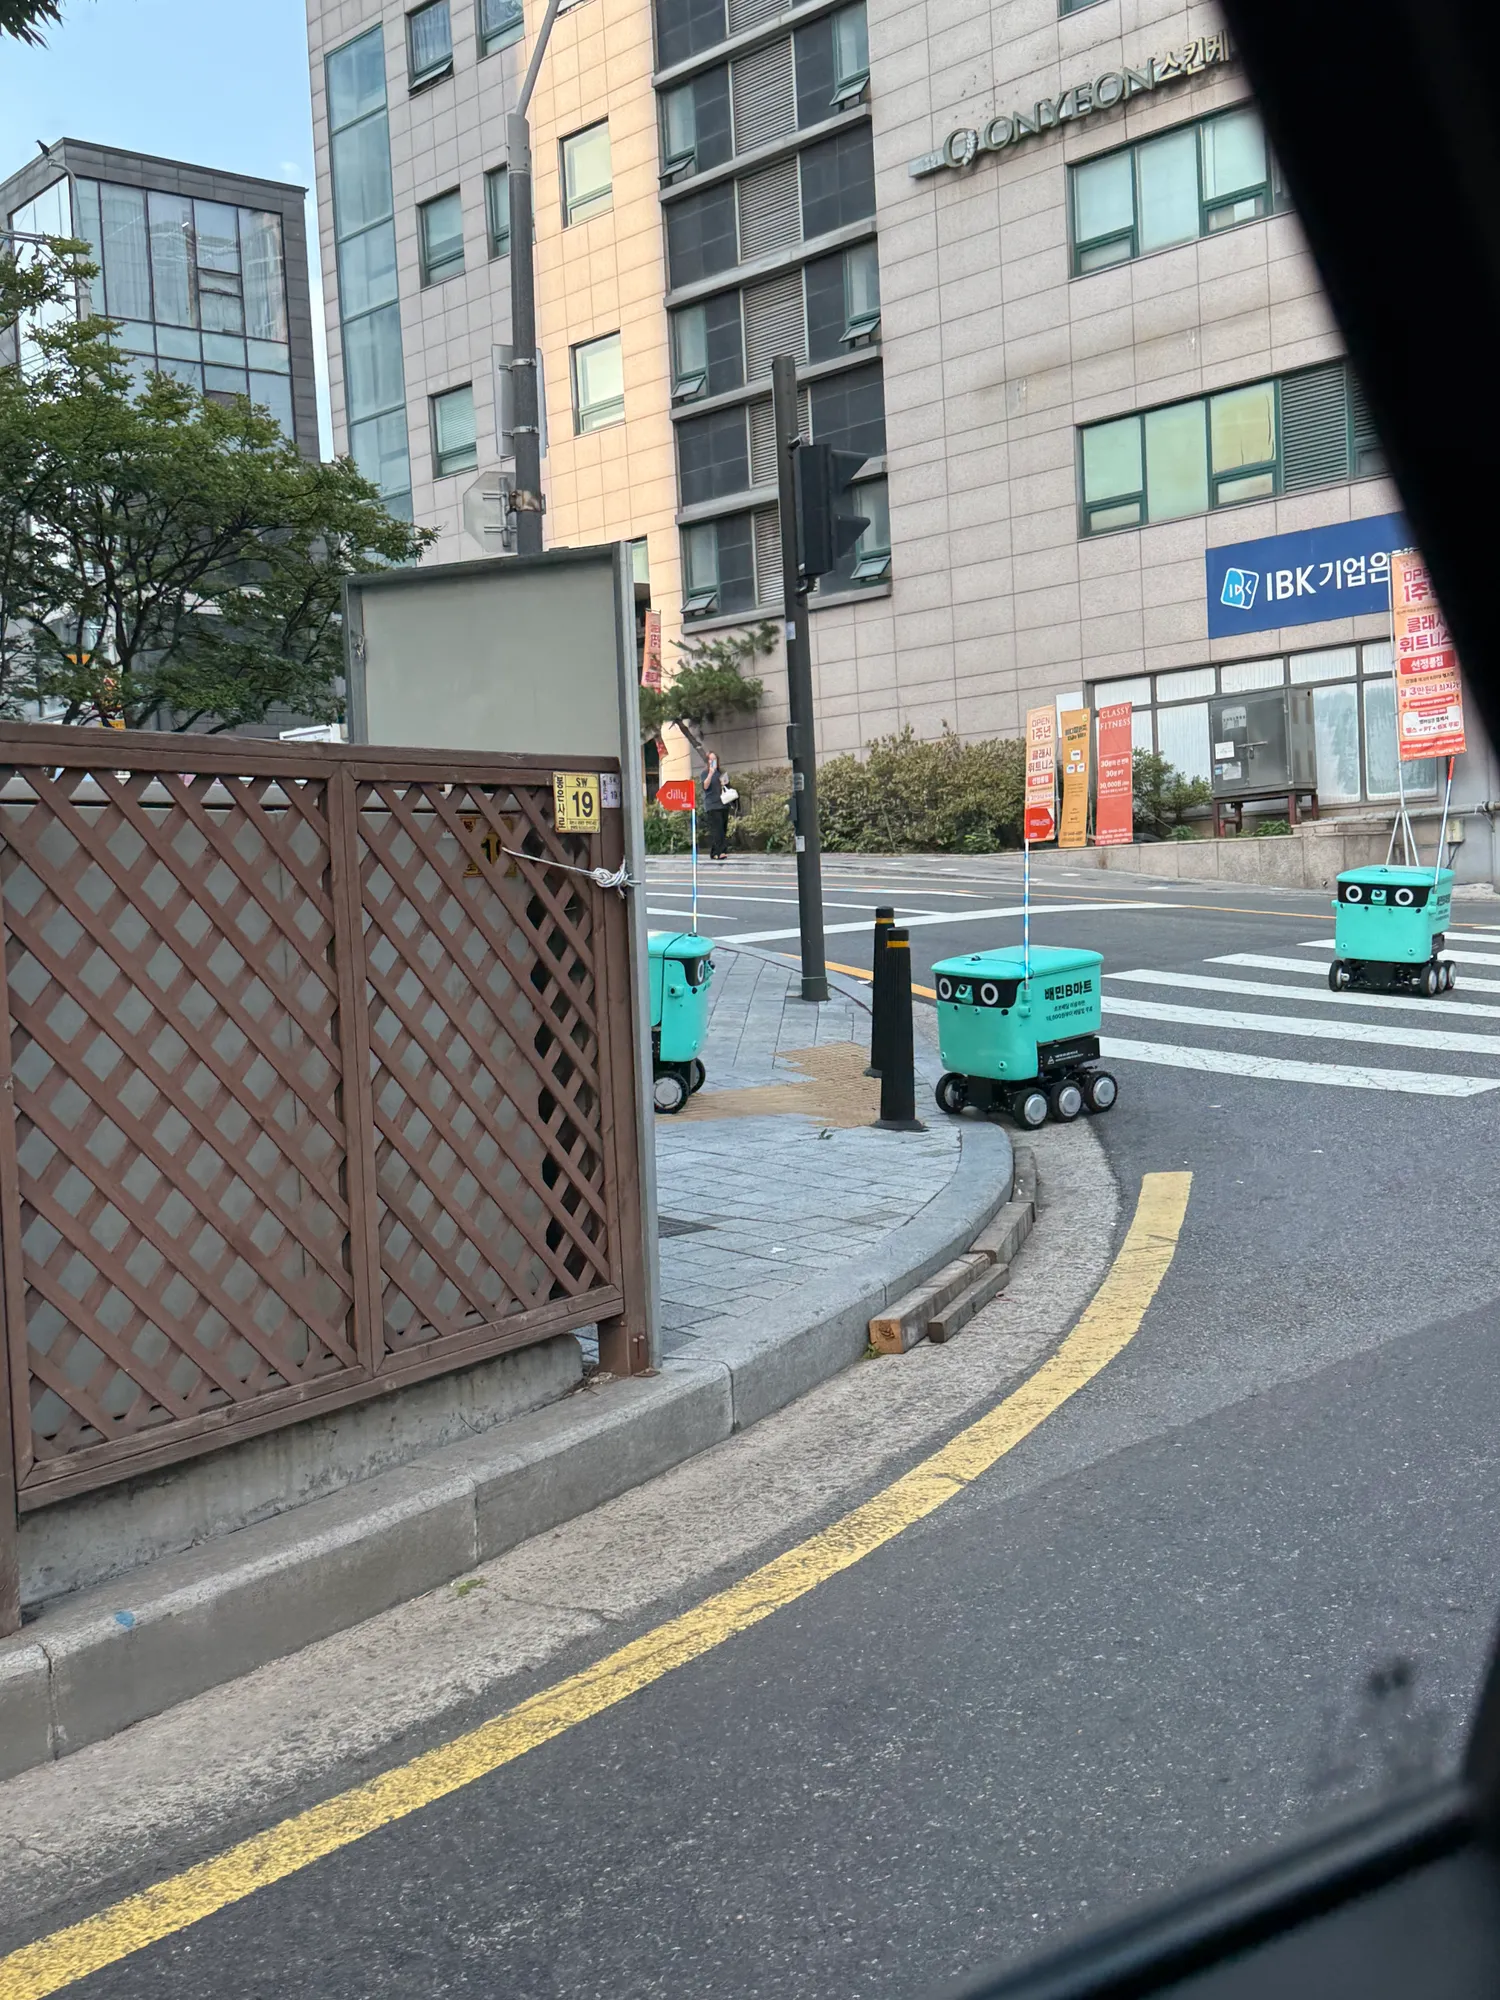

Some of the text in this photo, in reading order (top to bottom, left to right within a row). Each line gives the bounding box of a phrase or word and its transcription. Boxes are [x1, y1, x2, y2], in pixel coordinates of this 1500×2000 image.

[1266, 552, 1389, 601] IBK 기업은
[1101, 705, 1130, 720] CLASSY
[1032, 717, 1050, 728] OPEN
[1100, 718, 1131, 732] FITNESS
[576, 777, 588, 787] SW
[666, 789, 687, 803] dilly
[572, 791, 593, 818] 19
[1044, 979, 1093, 1001] 배민B마트
